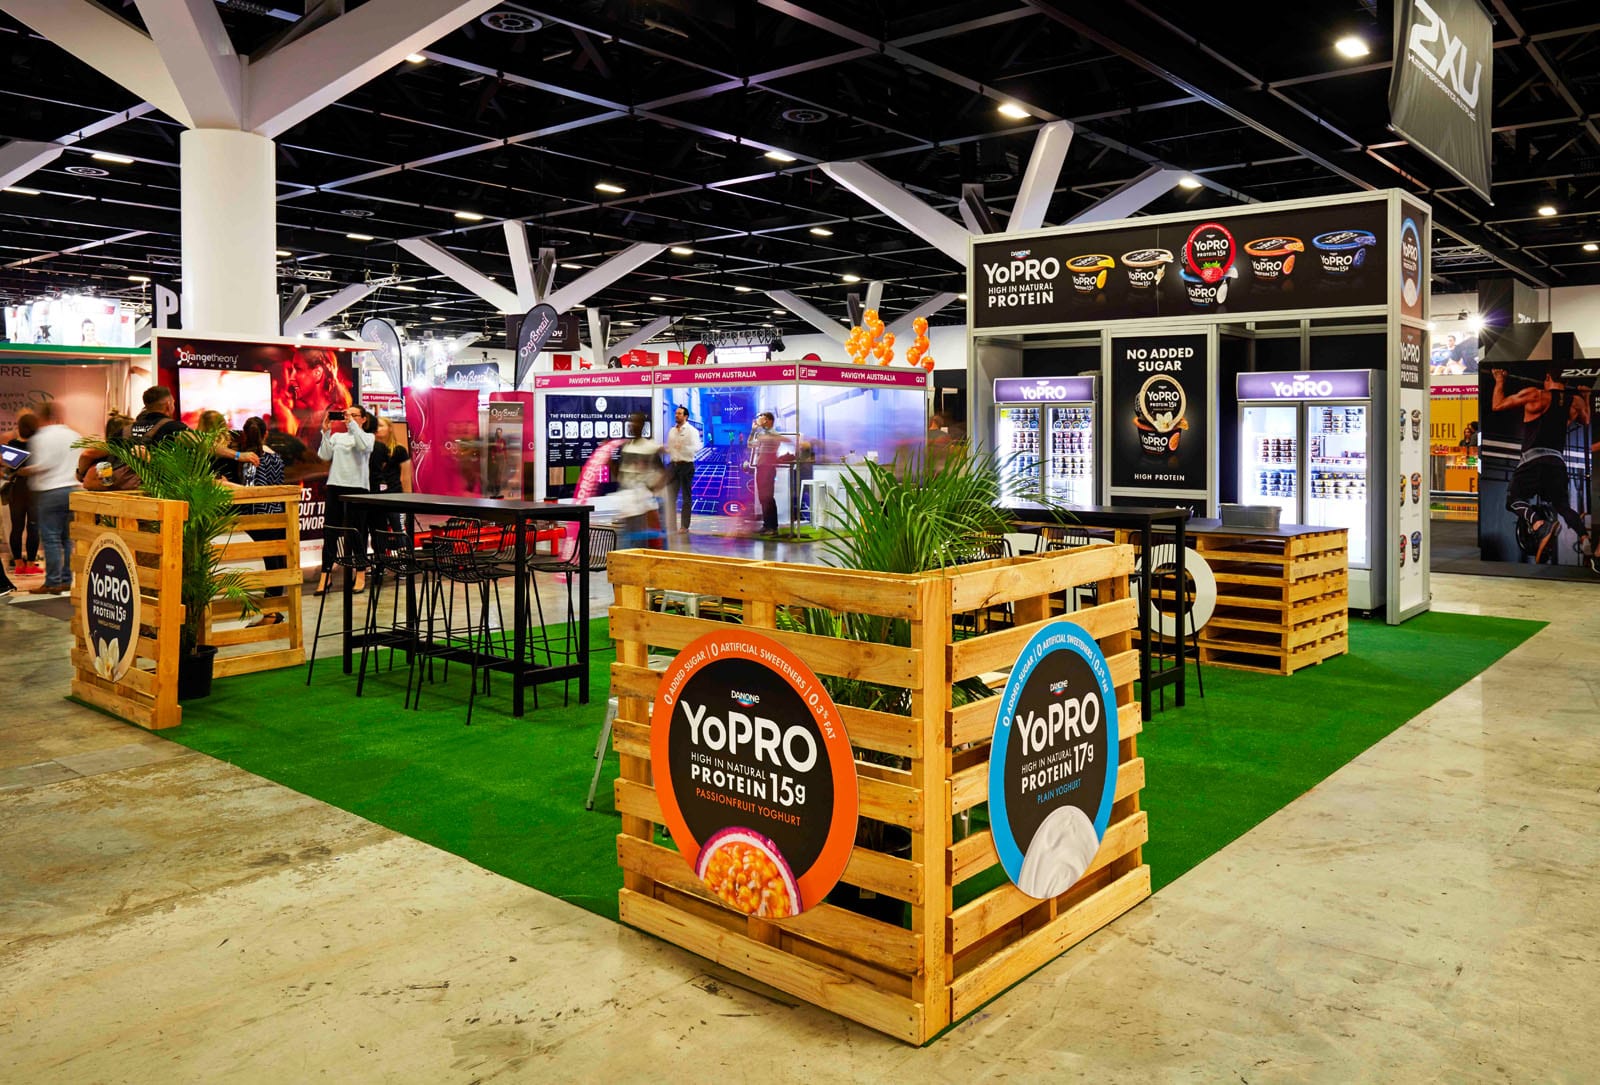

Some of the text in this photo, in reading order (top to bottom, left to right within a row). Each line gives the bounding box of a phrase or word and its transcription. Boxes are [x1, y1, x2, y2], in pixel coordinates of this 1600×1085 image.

[1409, 0, 1482, 109] 2XU
[1194, 239, 1228, 251] YoPRO
[983, 257, 1060, 284] YoPRO
[1252, 261, 1282, 271] YoPRO
[1320, 255, 1352, 265] YoPRO
[988, 291, 1053, 308] PROTEIN
[989, 286, 1007, 294] HIGH
[1020, 282, 1053, 292] NATURAL
[1126, 348, 1194, 360] NO ADDED
[1138, 360, 1182, 372] SUGAR
[1020, 386, 1066, 399] YoPRO
[1147, 392, 1179, 402] YoPRO
[1270, 381, 1333, 396] YoPRO
[91, 571, 130, 604] YoPRO
[93, 605, 126, 622] PROTEIN 15g
[664, 642, 836, 740] 0 ADDED SUGAR 0 ARTIFICIAL SWEETENERS 0.3% FAT
[1007, 682, 1020, 716] ADDED
[1018, 655, 1034, 682] SUGAR
[1036, 644, 1043, 656] 0
[731, 690, 760, 704] DANONE
[680, 700, 818, 773] YoPRO
[1016, 692, 1100, 756] YoPRO
[691, 752, 766, 780] HIGH IN NATURAL
[1022, 748, 1072, 774] HIGH IN NATURAL
[1022, 742, 1094, 794] PROTEIN 17g
[691, 764, 806, 806] PROTEIN 15g
[1037, 778, 1081, 804] PLAIN YOGHURT
[696, 788, 801, 826] PASSIONFRUIT YOGHURT
